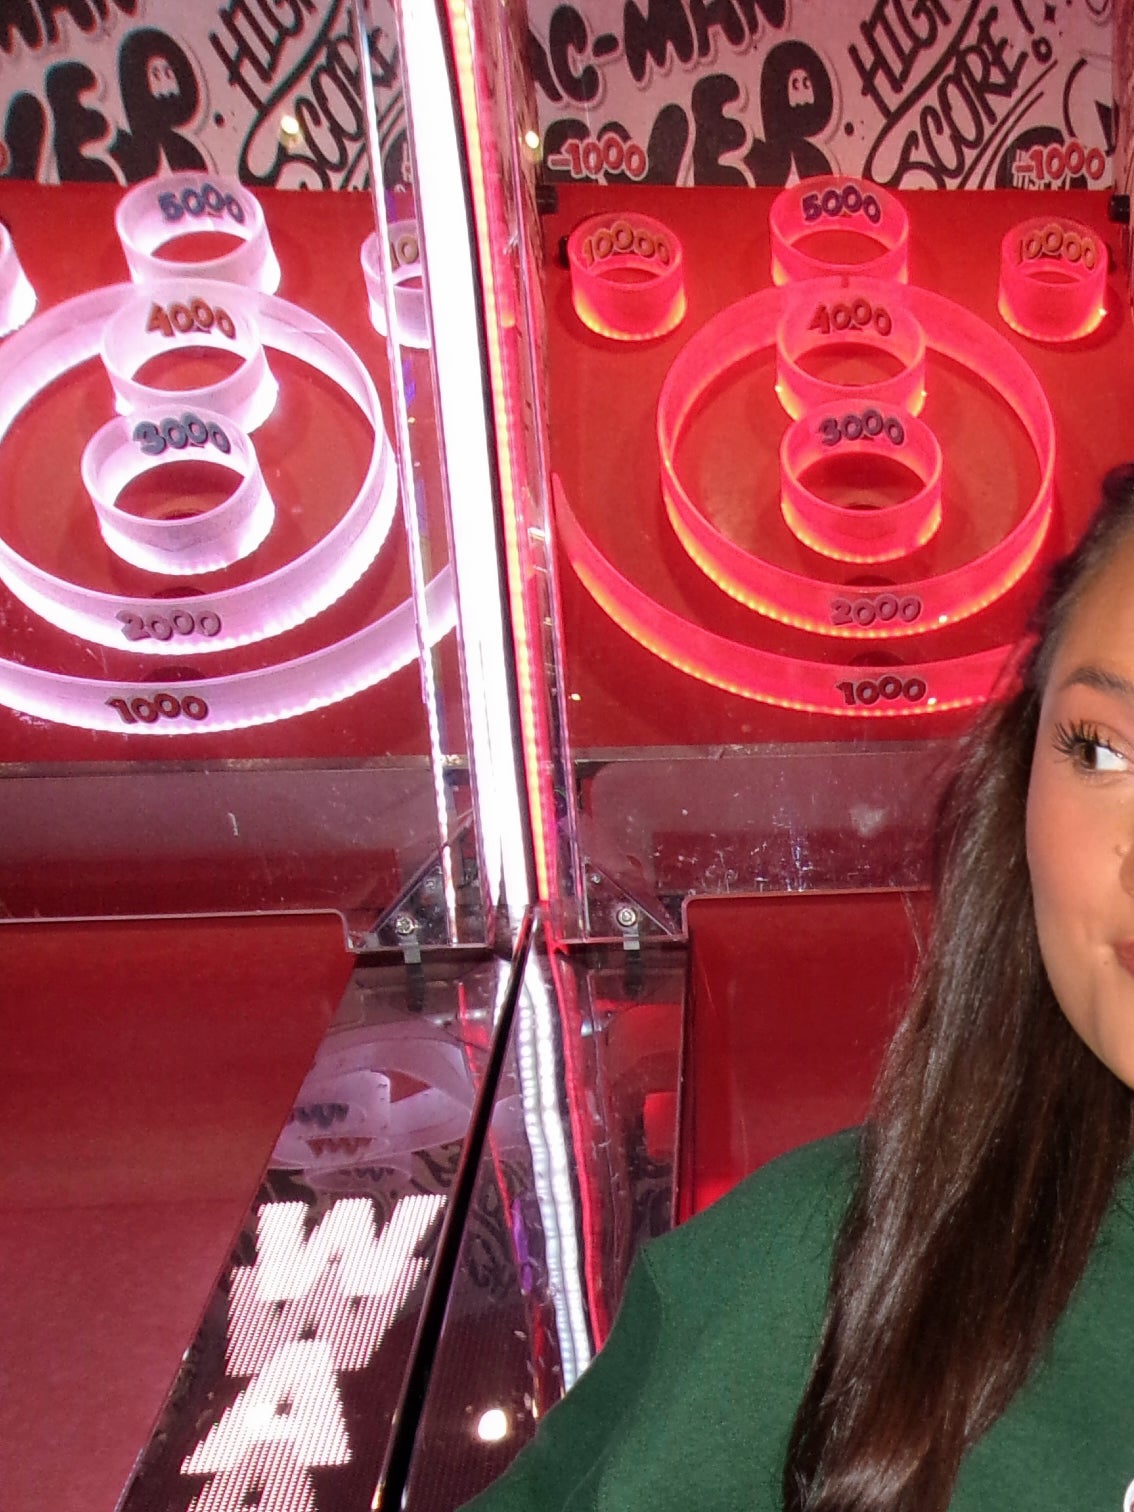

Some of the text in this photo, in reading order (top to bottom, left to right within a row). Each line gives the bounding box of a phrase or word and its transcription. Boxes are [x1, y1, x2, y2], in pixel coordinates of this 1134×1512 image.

[1014, 140, 1106, 181] -1000
[157, 184, 245, 225] 5000
[802, 184, 881, 225] 5000
[582, 220, 670, 268] 10000
[146, 298, 236, 339] 4000
[807, 298, 893, 336] 4000
[132, 411, 232, 456] 3000
[818, 408, 904, 447] 3000
[114, 609, 222, 642] 2000
[829, 595, 922, 627] 2000
[104, 692, 209, 725] 1000
[836, 675, 927, 706] 1000
